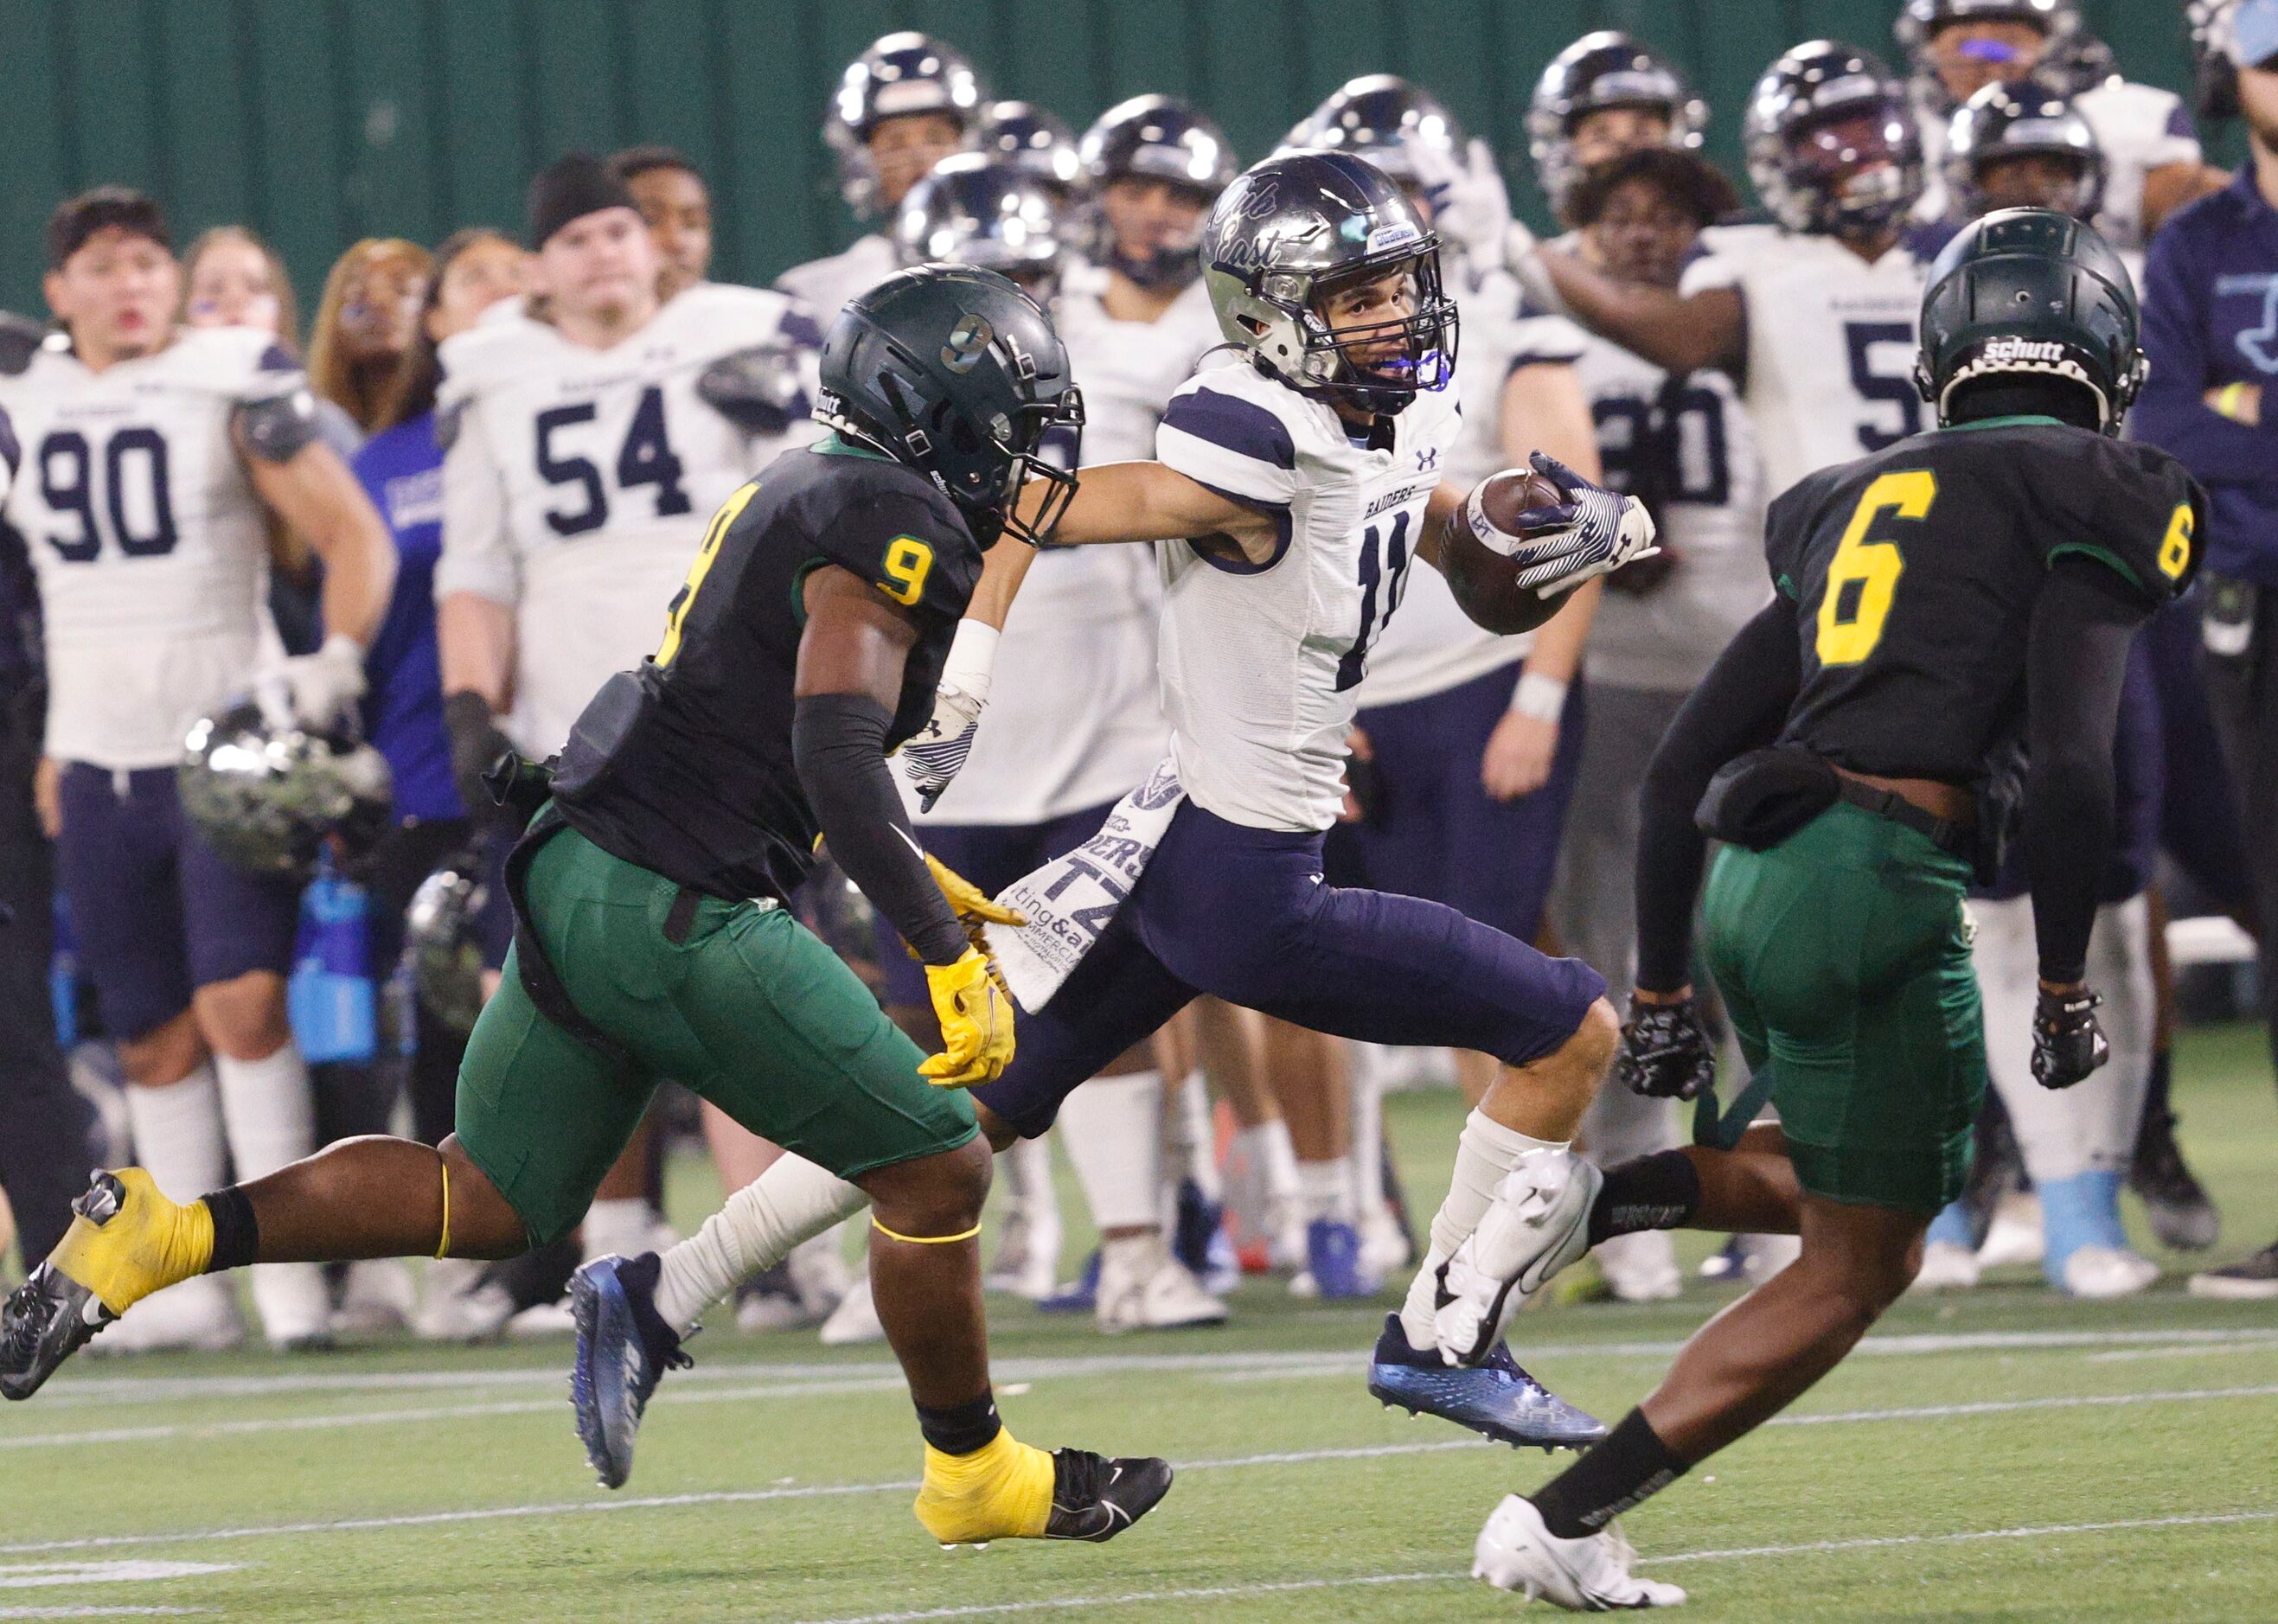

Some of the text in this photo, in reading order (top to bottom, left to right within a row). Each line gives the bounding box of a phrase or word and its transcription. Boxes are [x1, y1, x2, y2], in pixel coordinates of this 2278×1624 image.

[1216, 216, 1282, 270] East
[940, 313, 994, 374] 9
[1983, 336, 2065, 361] schutt
[41, 430, 178, 561] 90
[536, 386, 692, 536] 54
[1363, 485, 1417, 521] RAIDERS
[2158, 500, 2195, 580] 6
[874, 533, 937, 606] 9
[1335, 510, 1411, 693] 11
[1815, 468, 1938, 668] 6
